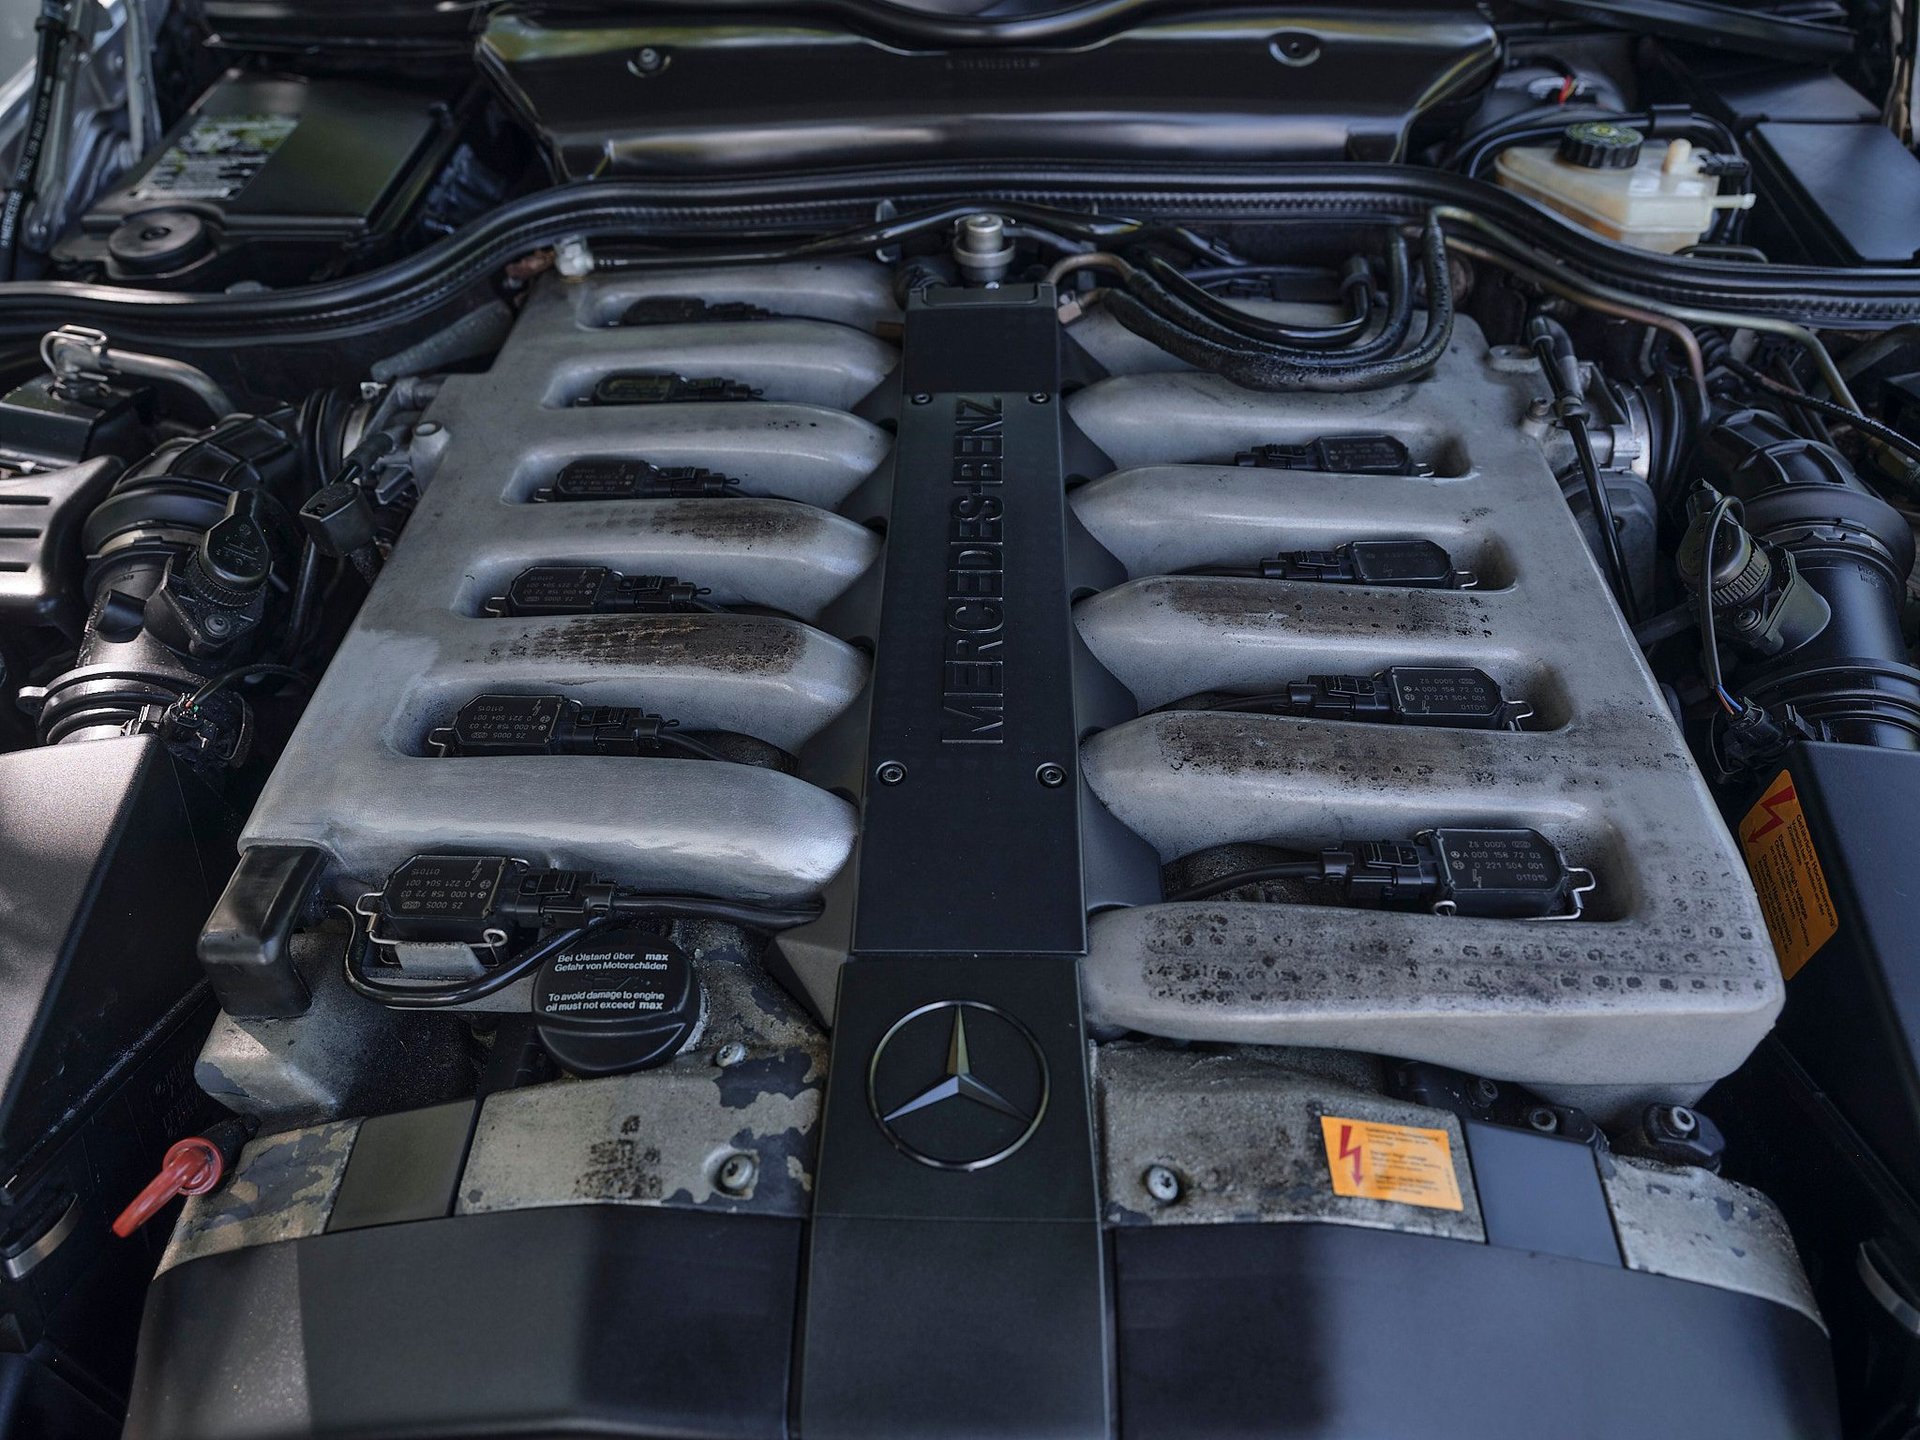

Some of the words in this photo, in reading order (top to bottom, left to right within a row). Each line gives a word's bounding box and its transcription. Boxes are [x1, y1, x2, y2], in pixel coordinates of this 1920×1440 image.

[942, 395, 1004, 744] MERCEDES-BENZ
[1471, 851, 1488, 859] 000
[426, 879, 442, 887] 504
[400, 889, 412, 897] 03
[416, 889, 427, 897] 72
[431, 890, 445, 898] 158
[450, 890, 467, 898] 000
[426, 901, 448, 909] 0005
[452, 901, 464, 909] ZS
[557, 954, 574, 963] Bei
[575, 952, 611, 962] Ölstand
[613, 952, 635, 960] über
[645, 953, 669, 961] max
[554, 963, 585, 972] Gefahr
[602, 961, 668, 971] Motorschäden
[548, 993, 560, 1002] To
[560, 991, 586, 1001] avoid
[587, 991, 622, 1000] damage
[623, 990, 633, 999] to
[633, 992, 665, 1000] engine
[545, 1003, 557, 1012] oil
[558, 1002, 582, 1011] must
[583, 1001, 599, 1010] not
[599, 1000, 636, 1010] exceed
[638, 1002, 663, 1010] max
